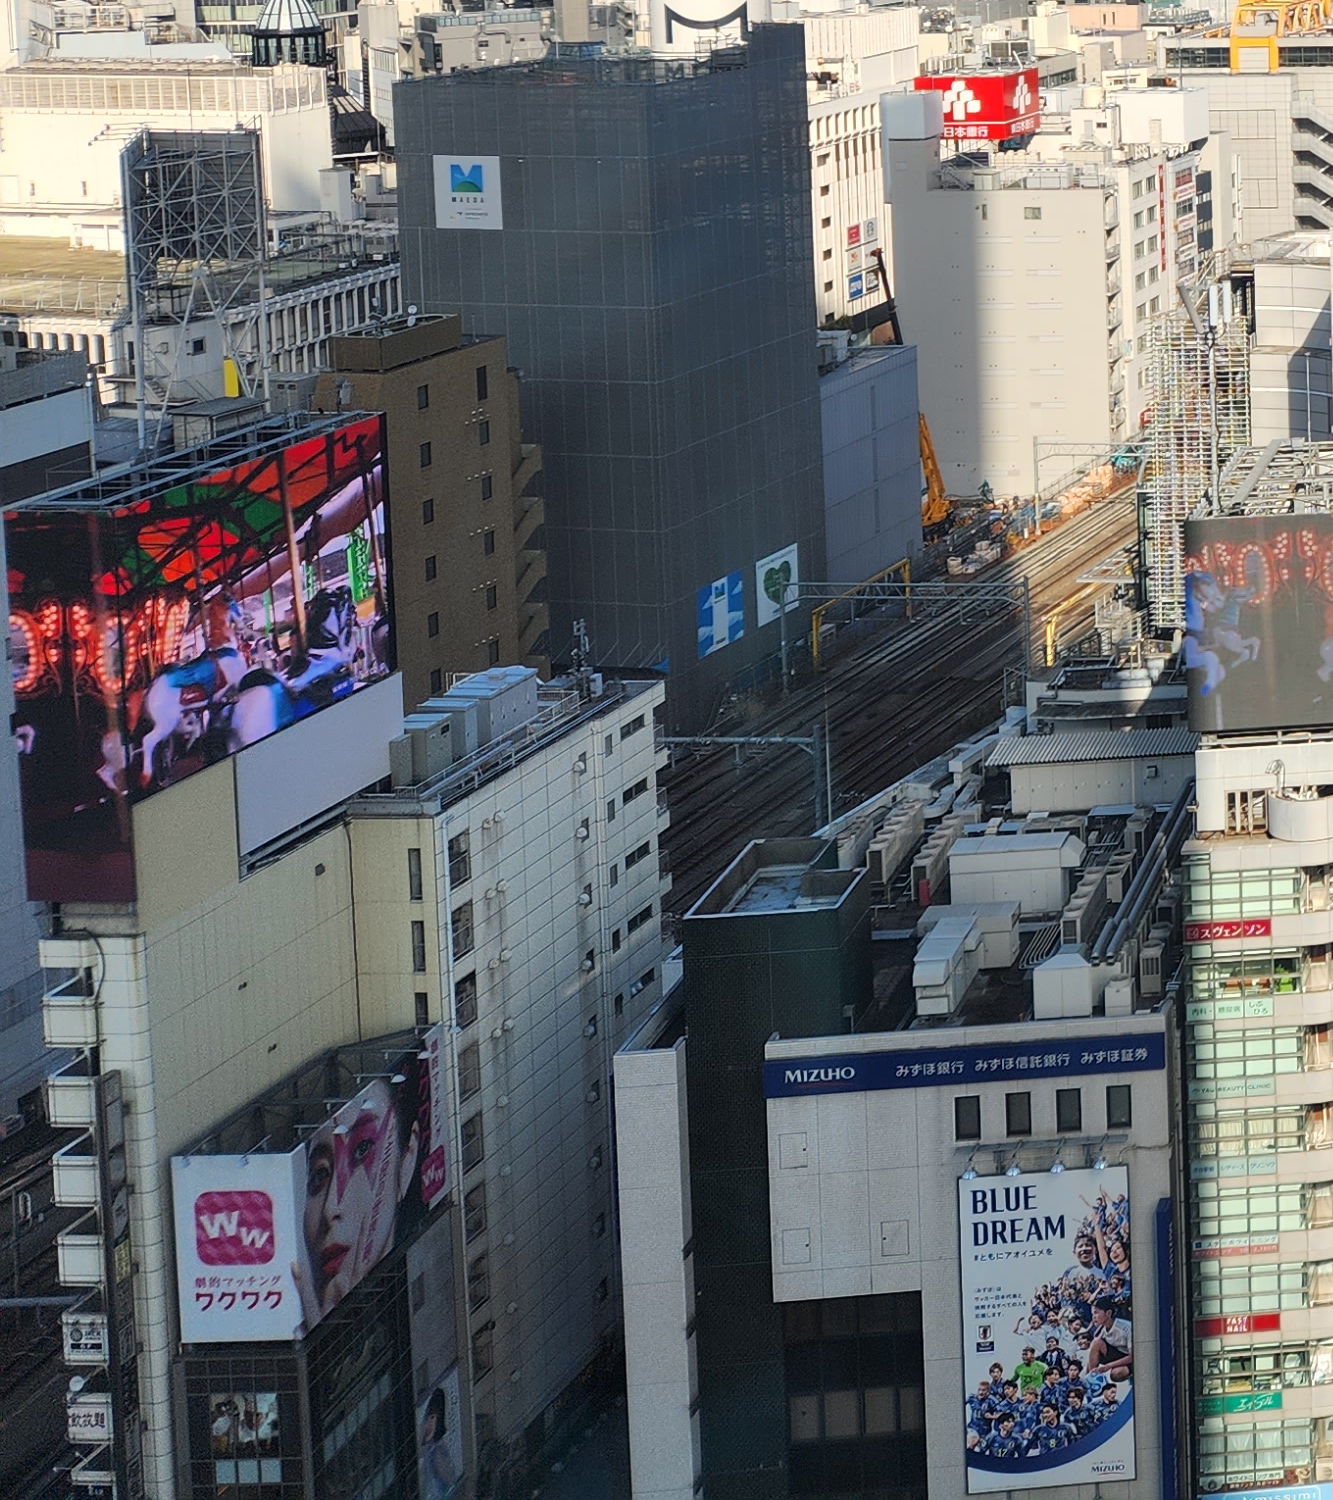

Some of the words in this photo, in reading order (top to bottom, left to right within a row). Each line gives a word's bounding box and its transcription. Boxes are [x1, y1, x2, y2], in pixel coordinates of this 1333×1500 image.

[1201, 924, 1266, 938] スヴェンソン
[896, 1061, 964, 1078] みずほ銀行
[975, 1052, 1070, 1072] みずほ信託銀行
[1080, 1048, 1148, 1065] みずほ証券
[785, 1066, 855, 1085] MIZUHO
[970, 1185, 1037, 1215] BLUE
[971, 1214, 1065, 1247] DREAM
[195, 1291, 282, 1312] ワクワク
[1226, 1315, 1247, 1325] FAST
[1226, 1324, 1247, 1334] NAIL
[1233, 1393, 1274, 1412] エイブル
[1091, 1463, 1126, 1473] MIZUHO
